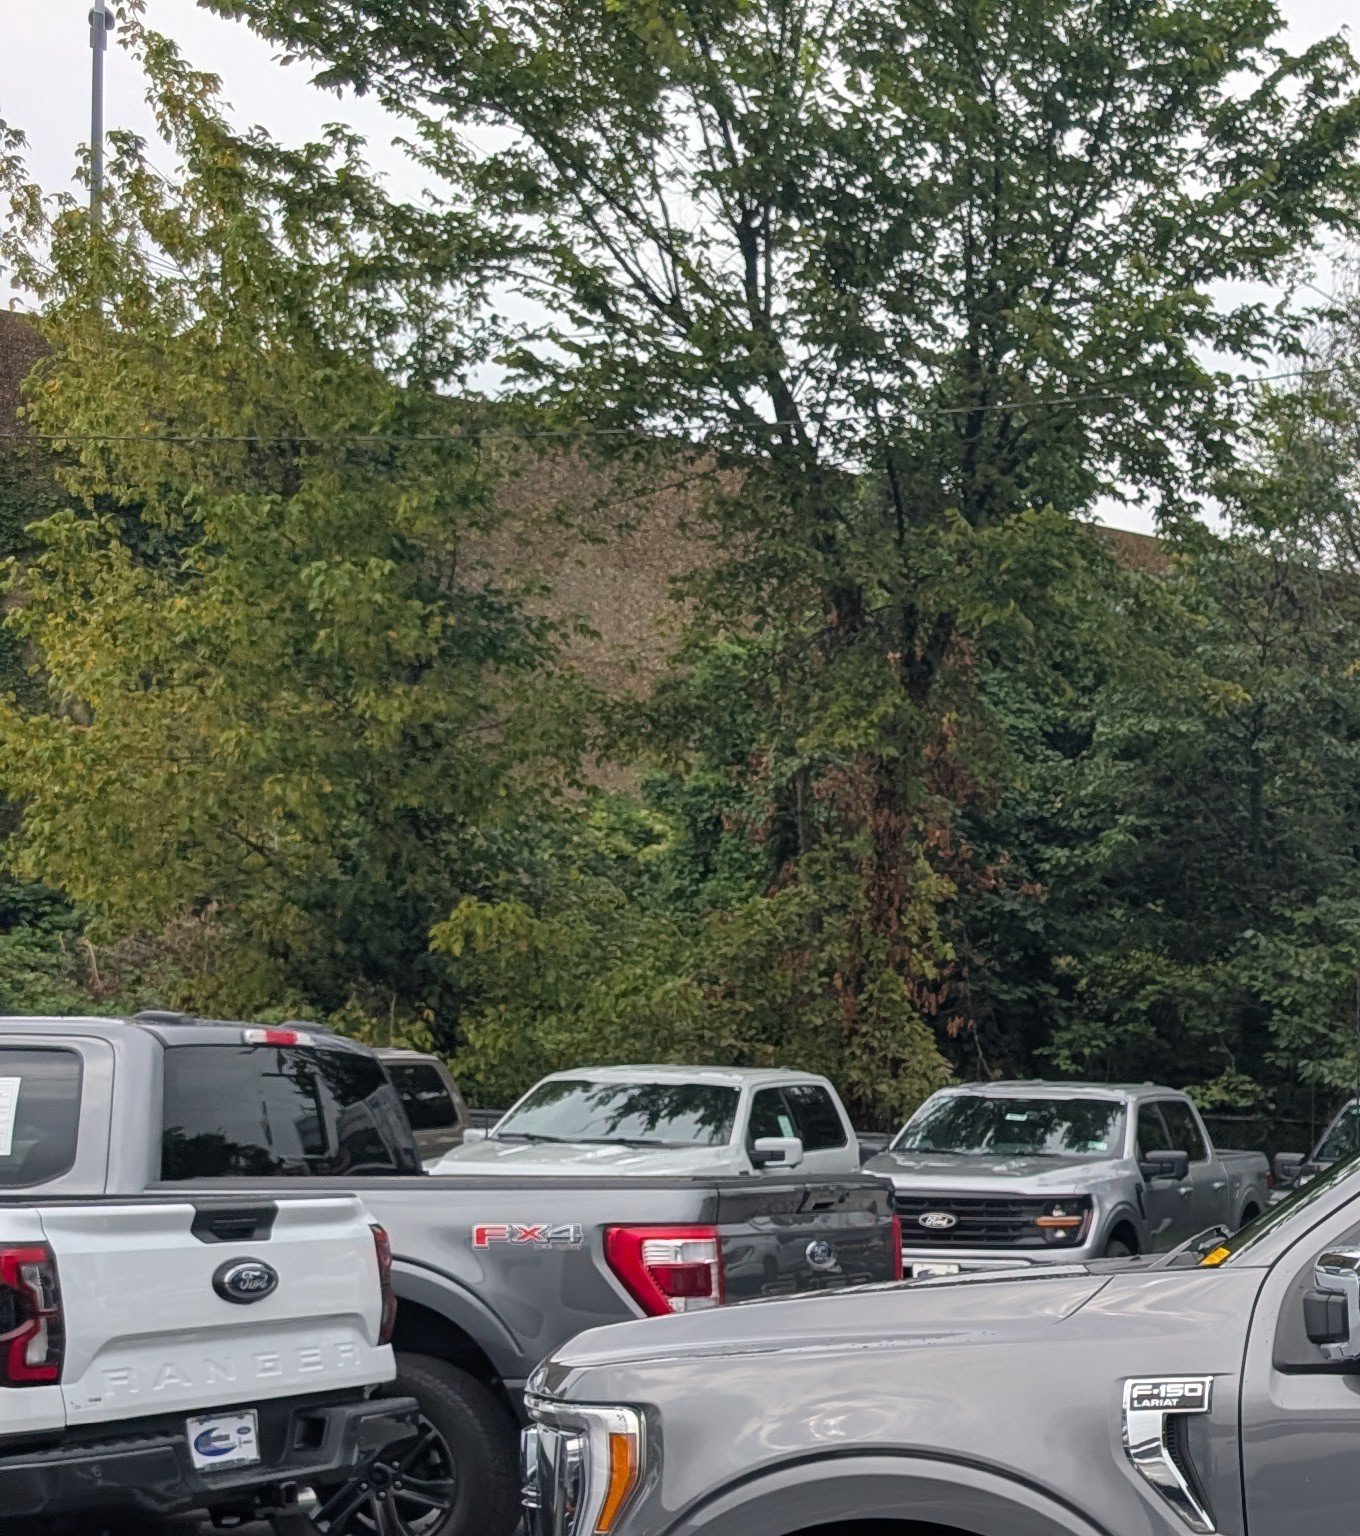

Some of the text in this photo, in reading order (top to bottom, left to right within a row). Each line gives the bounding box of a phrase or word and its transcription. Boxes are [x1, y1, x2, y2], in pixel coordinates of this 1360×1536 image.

[472, 1222, 584, 1250] FX4
[101, 1342, 363, 1397] RANGER
[1132, 1383, 1204, 1399] F-150
[1133, 1398, 1180, 1408] LARIAT
